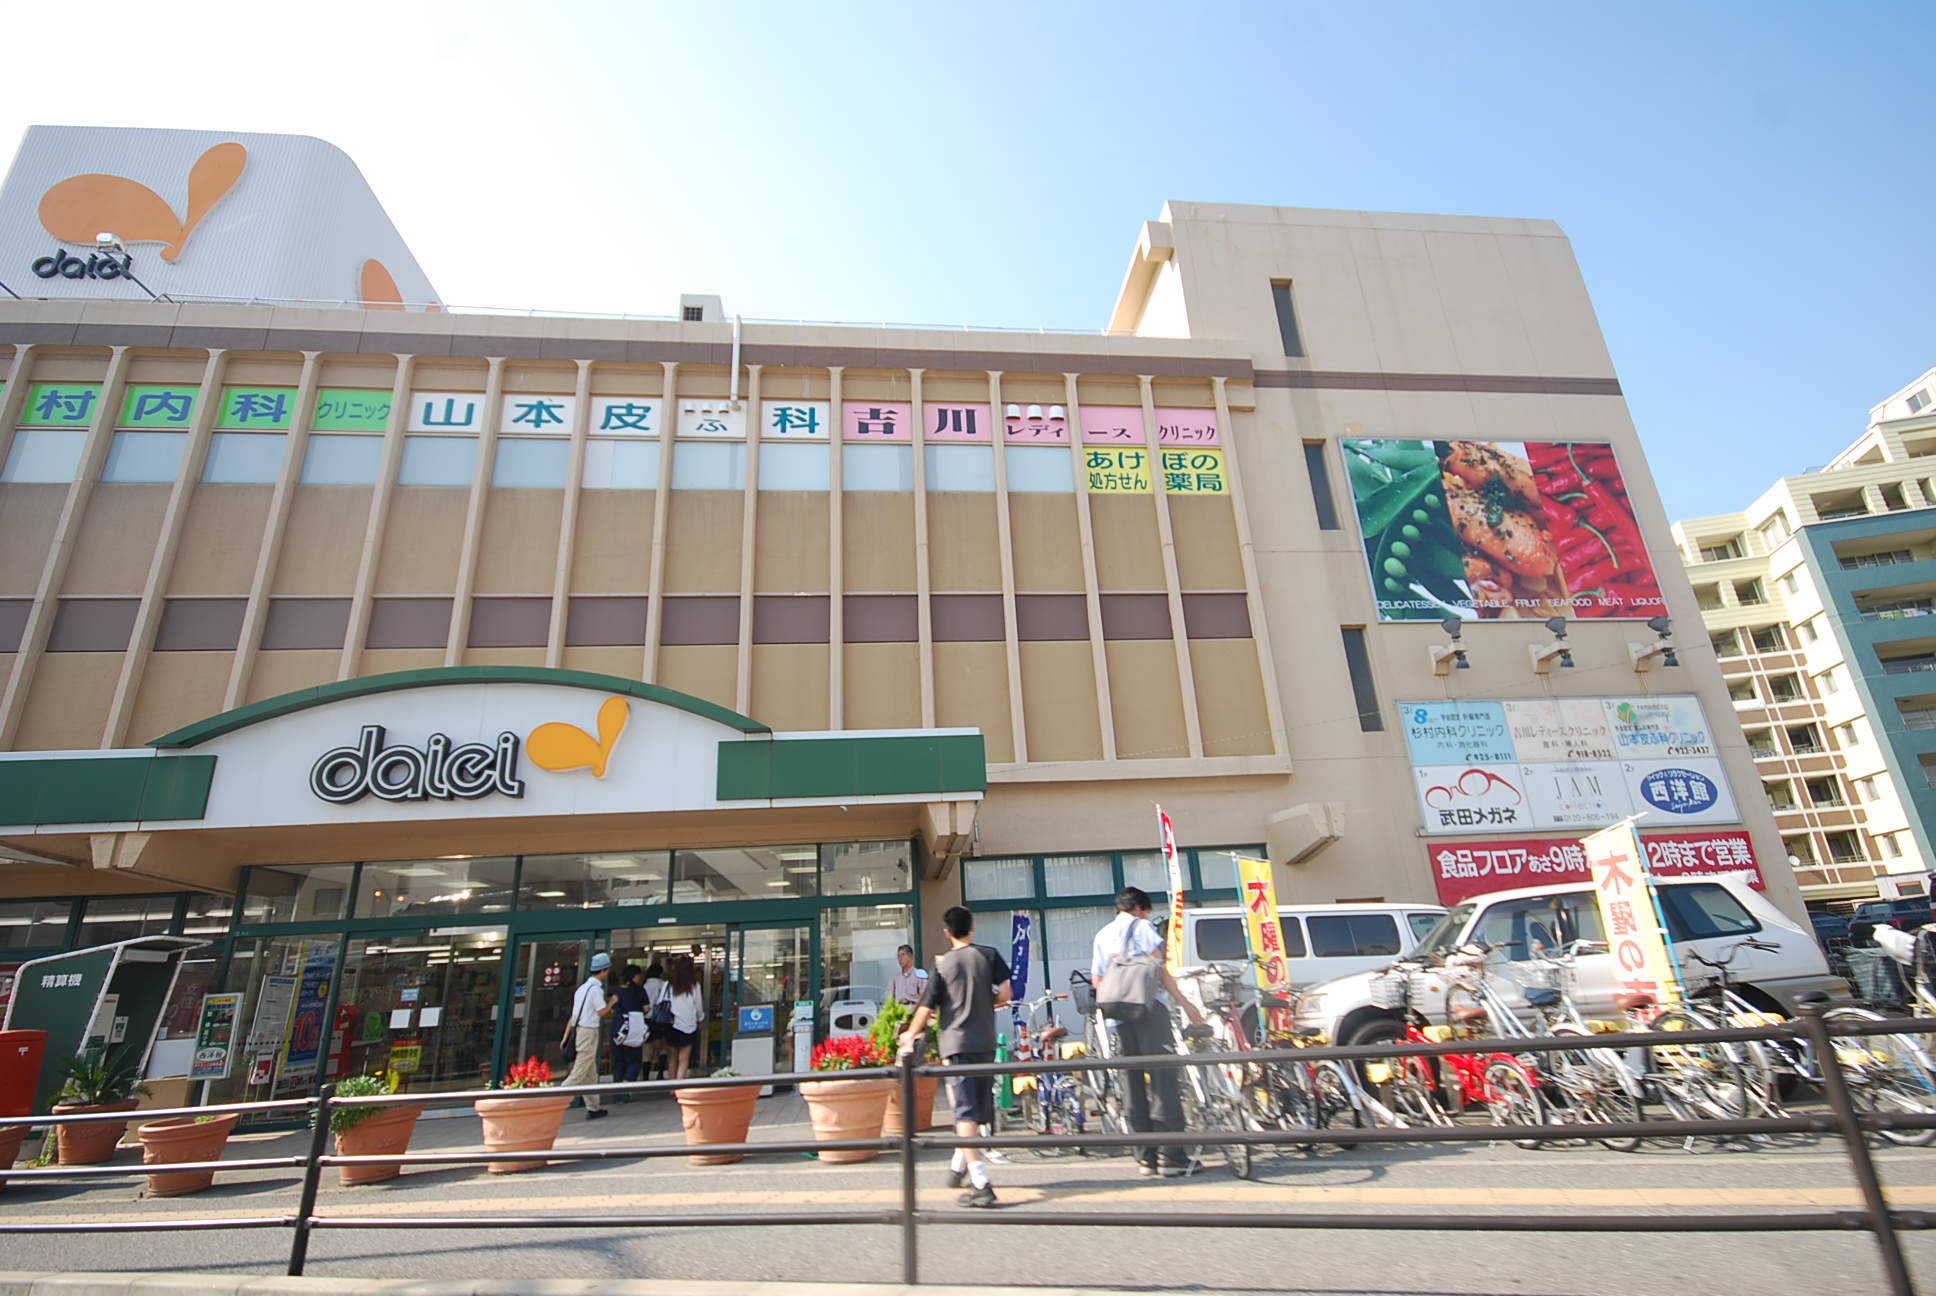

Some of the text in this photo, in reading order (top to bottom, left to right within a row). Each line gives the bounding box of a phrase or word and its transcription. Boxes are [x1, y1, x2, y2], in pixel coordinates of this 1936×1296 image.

[31, 248, 133, 280] daiei
[1451, 600, 1509, 608] VEGETABLE
[1515, 599, 1541, 608] FRUIT
[1550, 598, 1592, 607] SEAFOOD
[1599, 598, 1624, 607] MEAT
[1631, 597, 1665, 606] LIQUOR
[310, 725, 525, 805] daiei
[1648, 778, 1710, 802] 西洋館
[1438, 808, 1517, 827] 武田メガネ
[40, 973, 83, 988] 精算機
